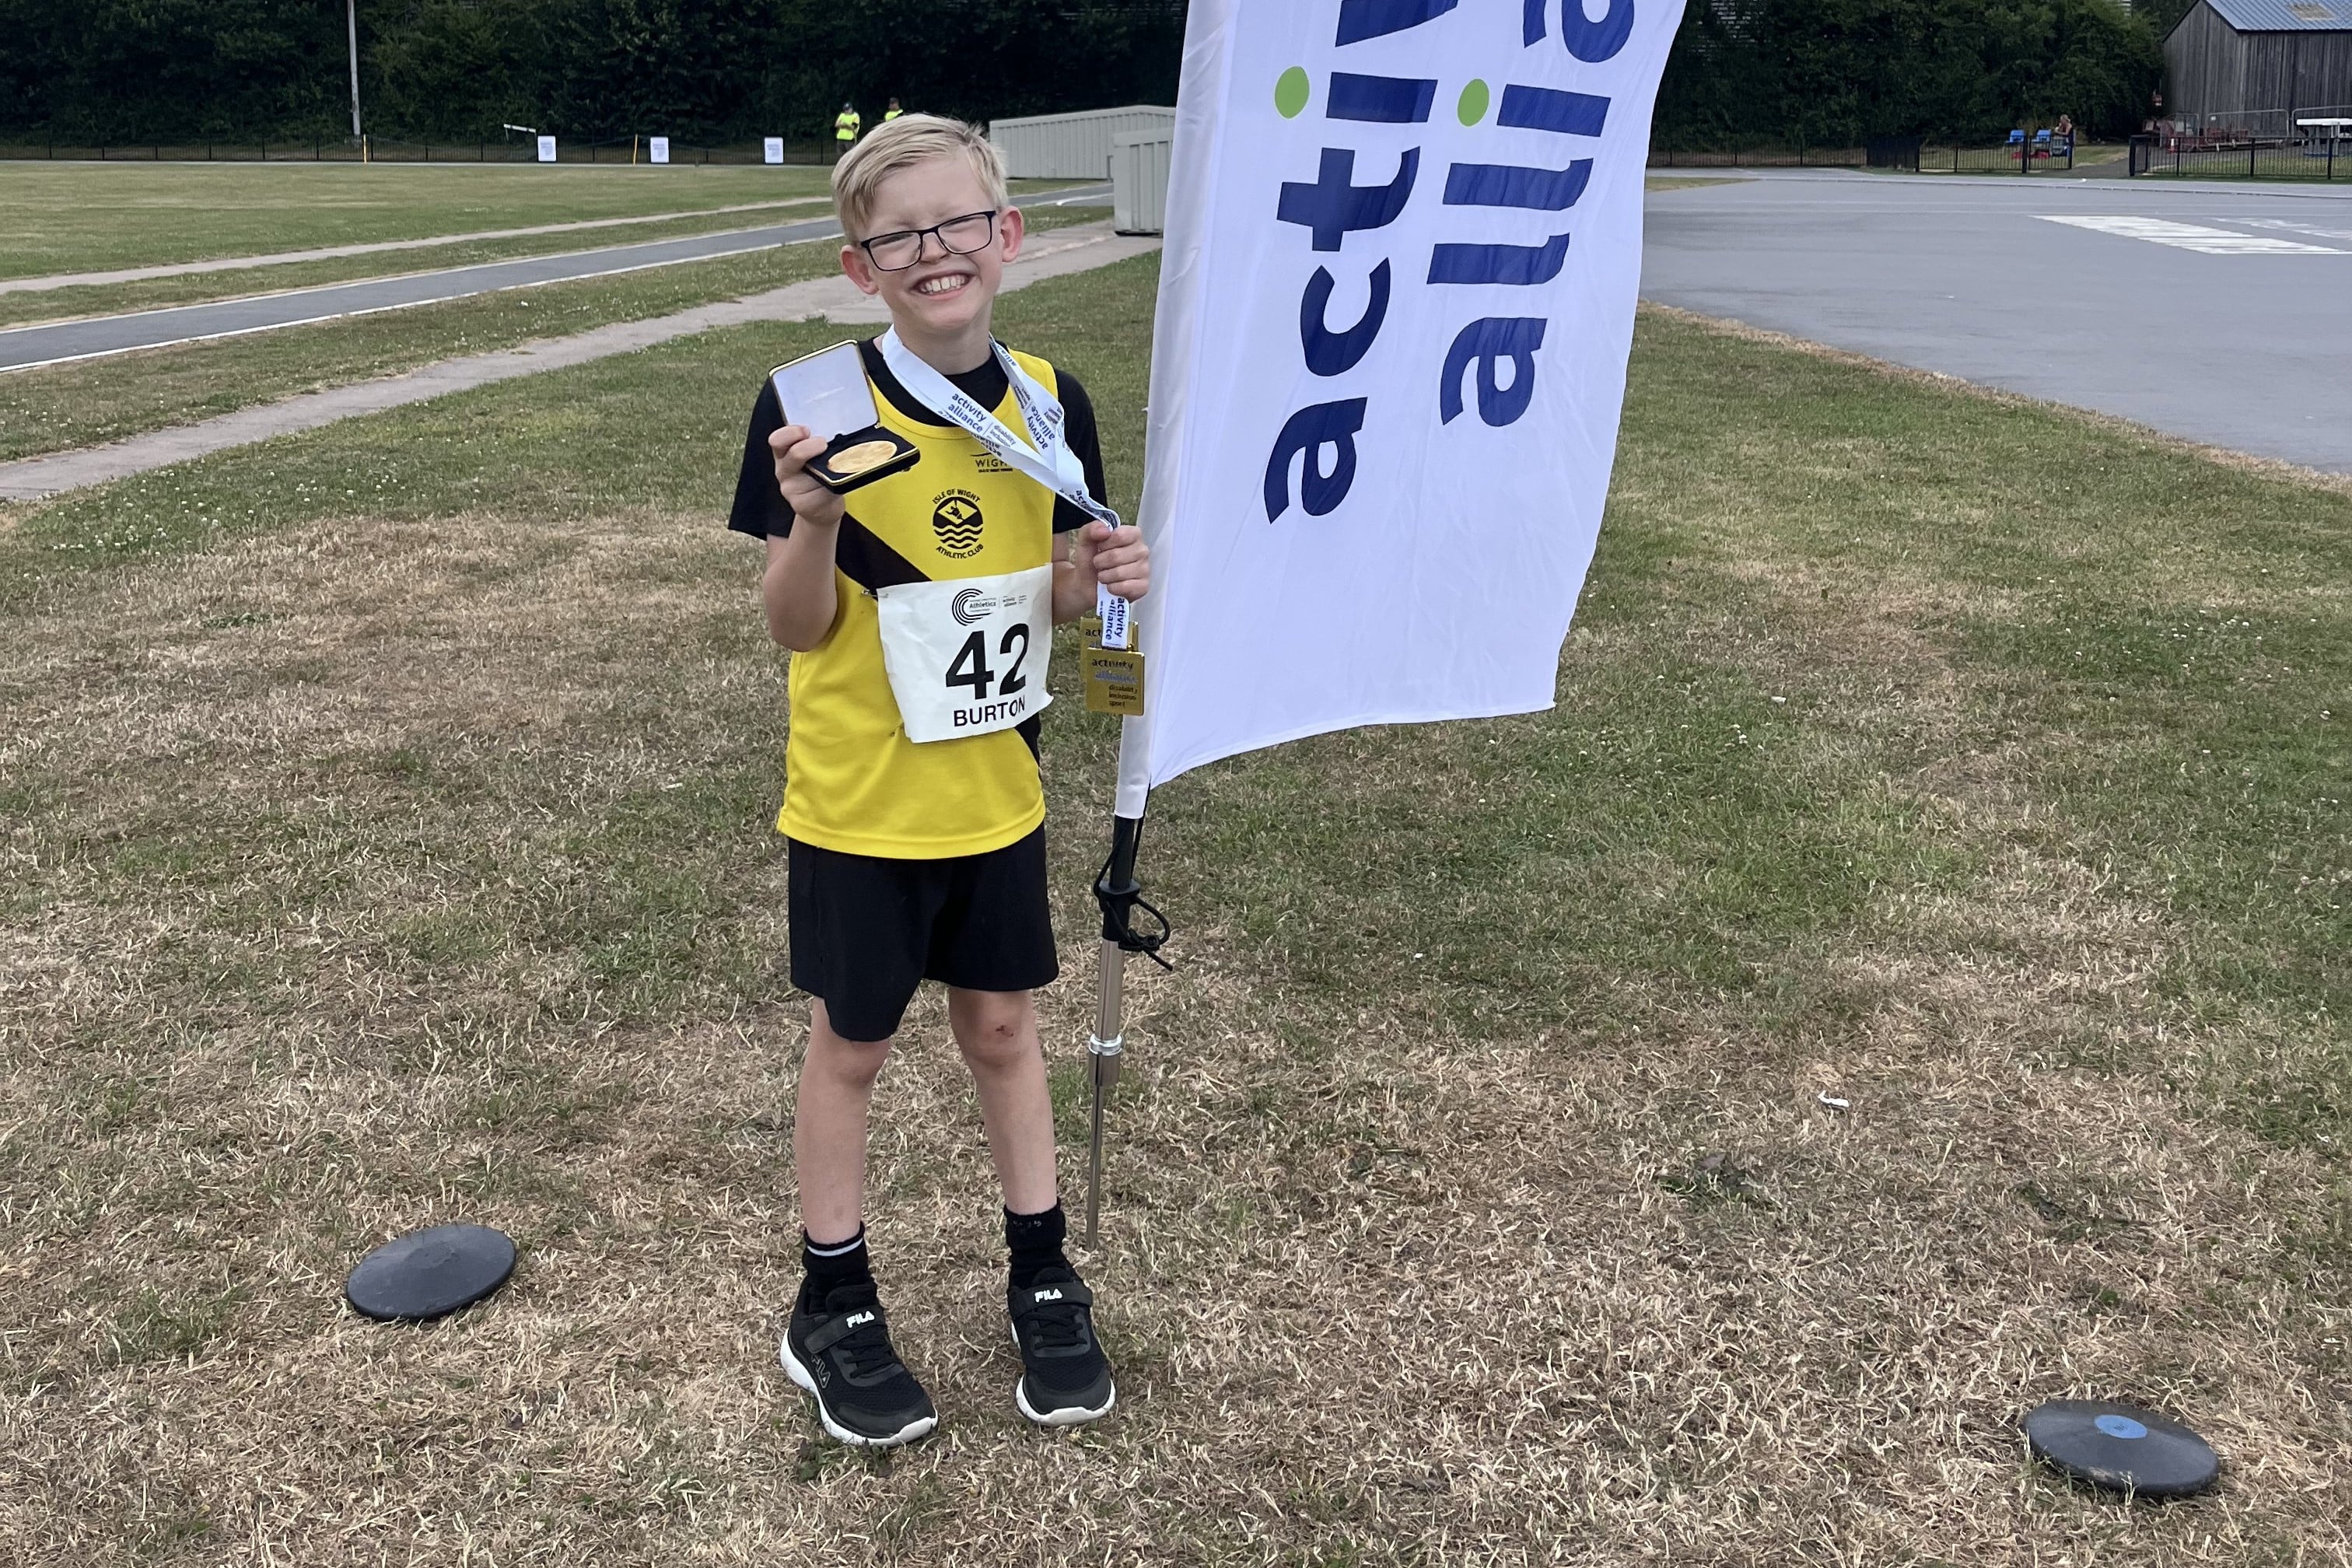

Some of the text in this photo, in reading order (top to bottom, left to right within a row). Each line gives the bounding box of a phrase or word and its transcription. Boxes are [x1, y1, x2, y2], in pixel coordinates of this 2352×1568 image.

[948, 404, 983, 433] alliance
[952, 393, 987, 422] activity
[1031, 405, 1055, 440] alliance
[1027, 416, 1048, 450] activity
[975, 458, 1009, 467] WIGH
[932, 492, 947, 505] ISLE
[957, 488, 981, 502] WIGHT
[936, 544, 984, 559] ATHLETIC CLUB
[1105, 598, 1116, 640] alliance
[1114, 597, 1125, 638] activity
[946, 623, 1030, 700] 42
[954, 695, 1026, 727] BURTON
[1034, 1288, 1063, 1303] FILA
[845, 1311, 875, 1328] FILA
[810, 1353, 831, 1389] FILA
